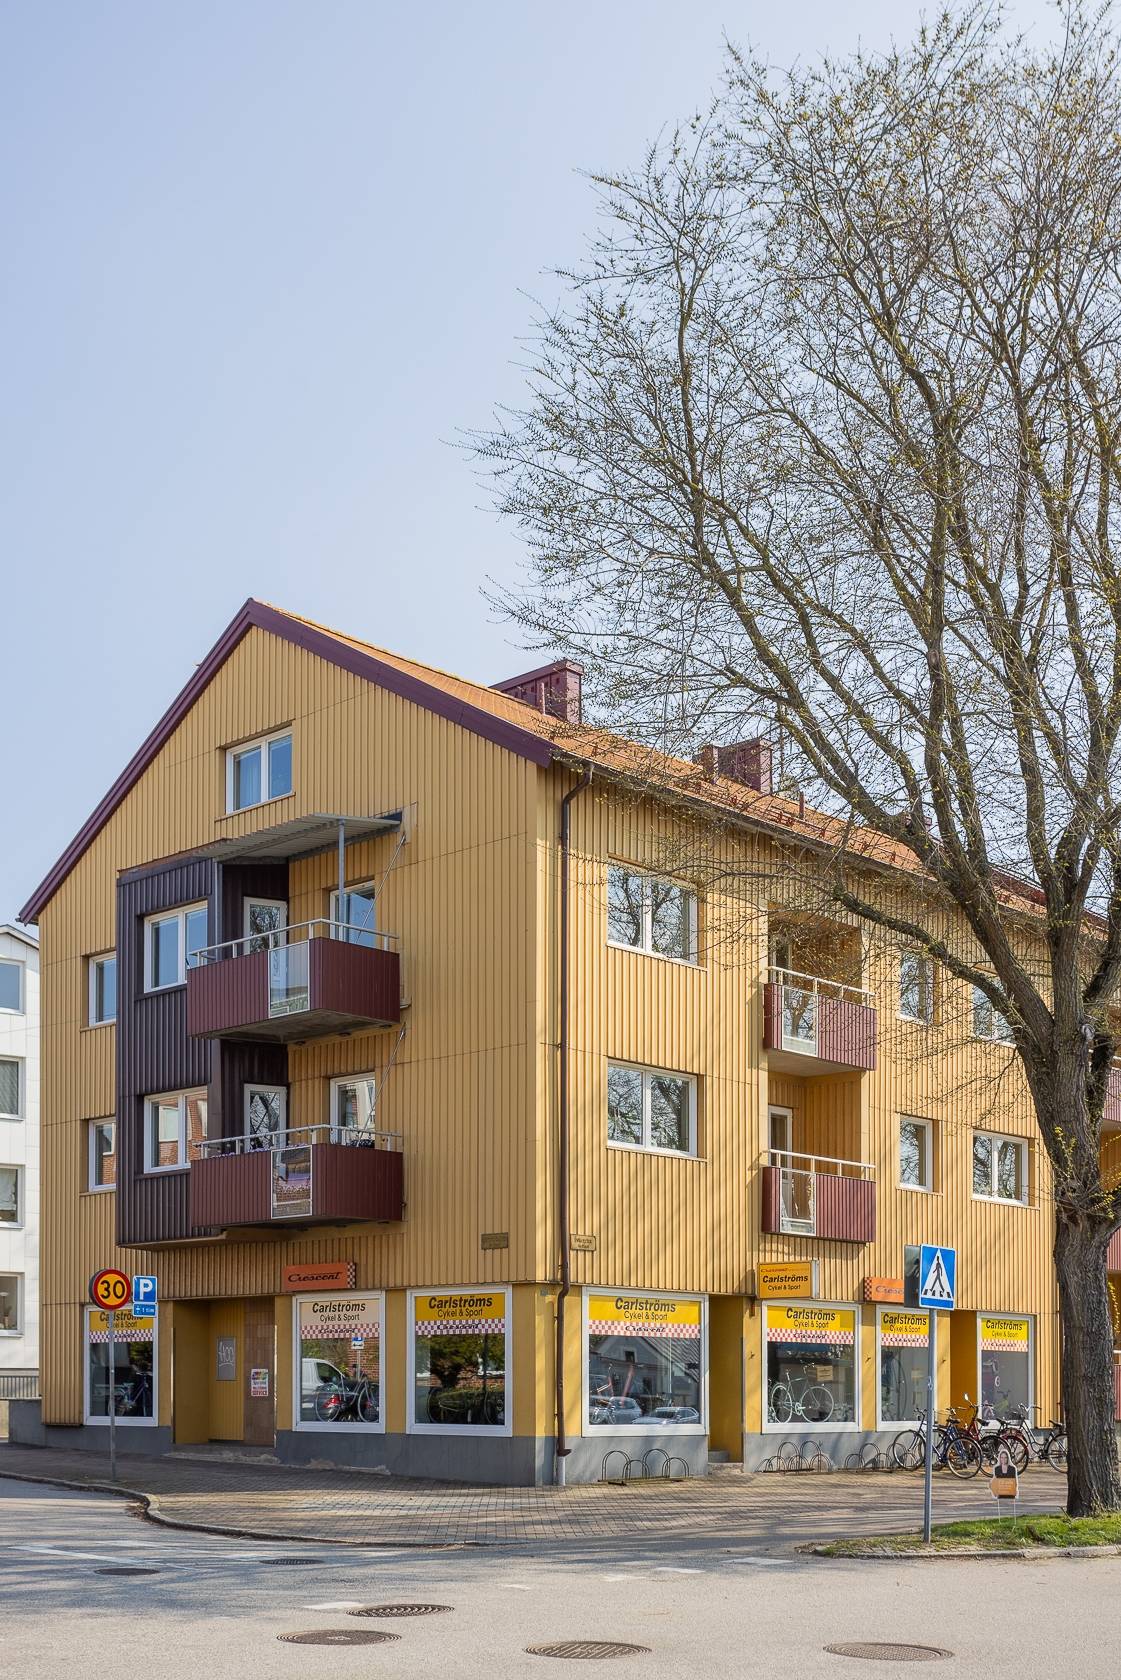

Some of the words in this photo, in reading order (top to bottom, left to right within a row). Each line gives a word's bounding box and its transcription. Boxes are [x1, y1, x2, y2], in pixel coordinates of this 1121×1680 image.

[287, 1271, 343, 1283] Crescent
[762, 1274, 809, 1284] Carlströms
[100, 1279, 126, 1300] 30
[139, 1278, 153, 1300] P
[787, 1284, 801, 1292] Sport
[312, 1301, 366, 1314] Carlströms
[428, 1295, 493, 1310] Carlströms
[615, 1297, 677, 1313] Carlströms
[320, 1314, 337, 1324] Cykel
[343, 1313, 360, 1323] Sport
[437, 1309, 457, 1319] Cykel
[465, 1308, 483, 1319] Sport
[623, 1310, 644, 1320] Cykel
[645, 1311, 650, 1319] &
[651, 1311, 668, 1322] Sport
[786, 1307, 836, 1321] Carlströms
[883, 1313, 927, 1326] Carlströms
[793, 1320, 810, 1329] Cykel
[815, 1321, 829, 1329] Sport
[985, 1319, 1023, 1331] Carlströms
